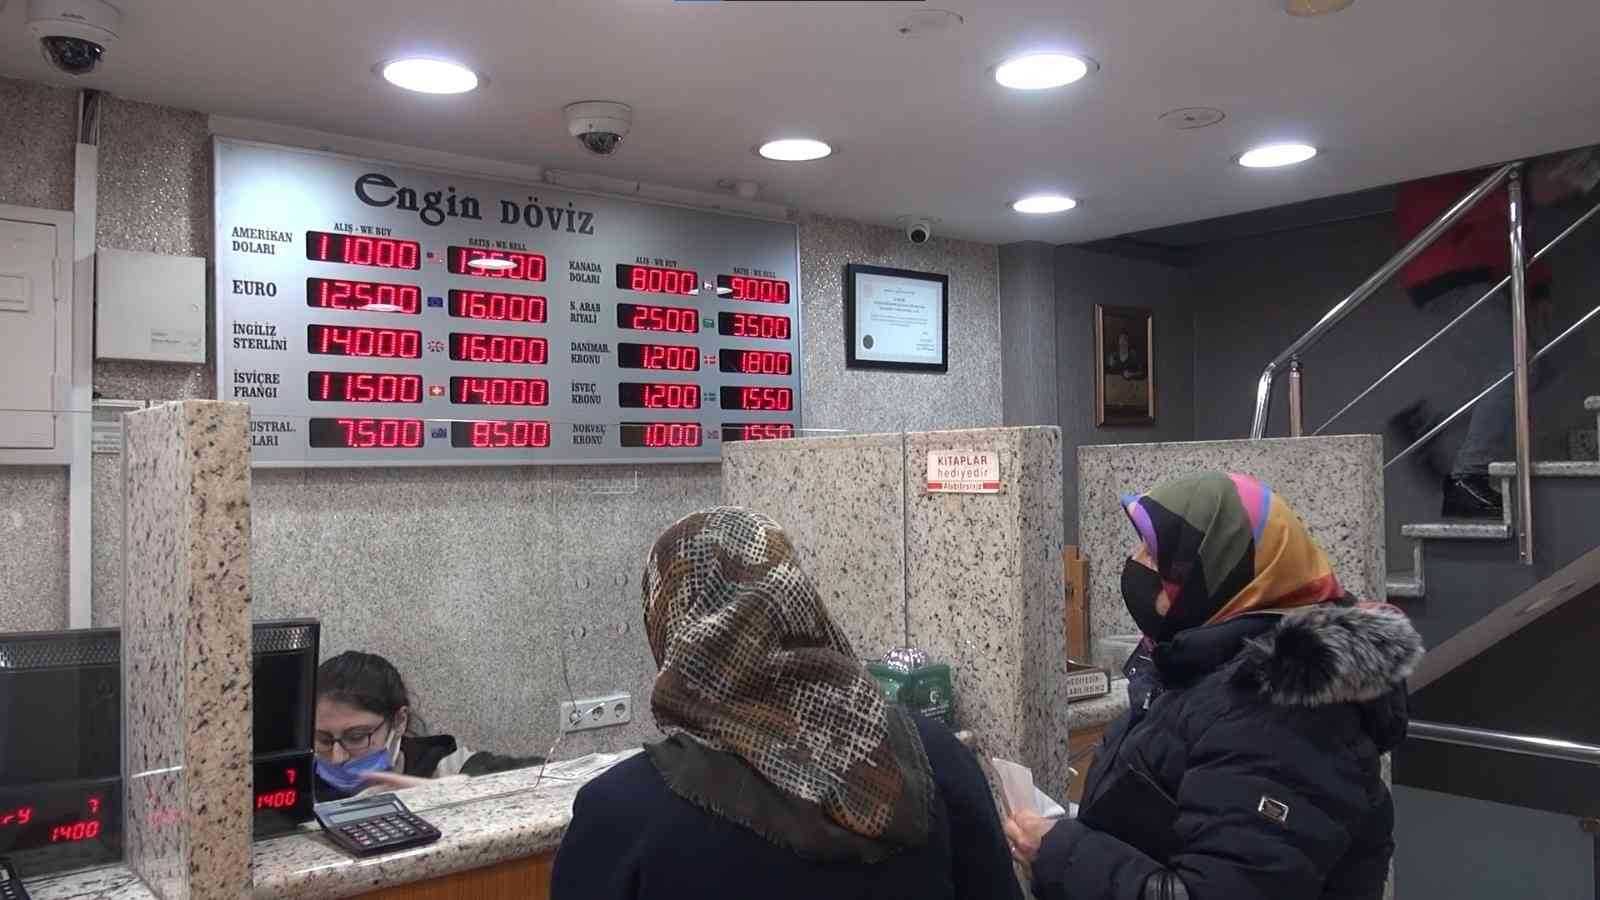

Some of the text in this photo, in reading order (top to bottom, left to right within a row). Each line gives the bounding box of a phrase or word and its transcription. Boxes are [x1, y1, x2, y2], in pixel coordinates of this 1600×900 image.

[500, 196, 595, 235] DÖVİZ
[360, 224, 372, 233] WE
[376, 227, 392, 236] BUY
[232, 240, 275, 255] DOLARI
[321, 235, 417, 269] 11.000
[569, 260, 602, 273] KANADA
[232, 279, 277, 298] EURO
[569, 272, 600, 284] DOLARI
[632, 268, 694, 295] 8.000
[321, 282, 417, 315] 12.500
[731, 277, 787, 303] 9.000
[461, 293, 544, 322] 16.000
[580, 302, 601, 313] ARAB
[233, 320, 277, 337] İNGİLİZ
[633, 307, 695, 333] 2.500
[734, 314, 788, 338] 3.500
[233, 337, 288, 351] STERLİNİ
[322, 326, 418, 357] 14.000
[462, 336, 545, 364] 16.000
[571, 354, 601, 364] KRONU
[643, 346, 696, 370] 1.200
[742, 352, 789, 374] 1.800
[322, 374, 419, 402] 11.500
[462, 379, 545, 405] 14.000
[644, 385, 697, 408] 1.200
[743, 388, 790, 410] 1.550
[571, 395, 601, 404] KRONU
[248, 421, 296, 432] USTRAL.
[338, 418, 421, 446] 7.500
[473, 420, 548, 447] 8.500
[646, 424, 699, 447] 1.000
[248, 435, 280, 446] LARI
[573, 435, 602, 445] KRONU
[287, 770, 297, 785] 7
[88, 798, 100, 814] 7
[257, 789, 297, 809] 1400
[52, 820, 100, 842] 1400
